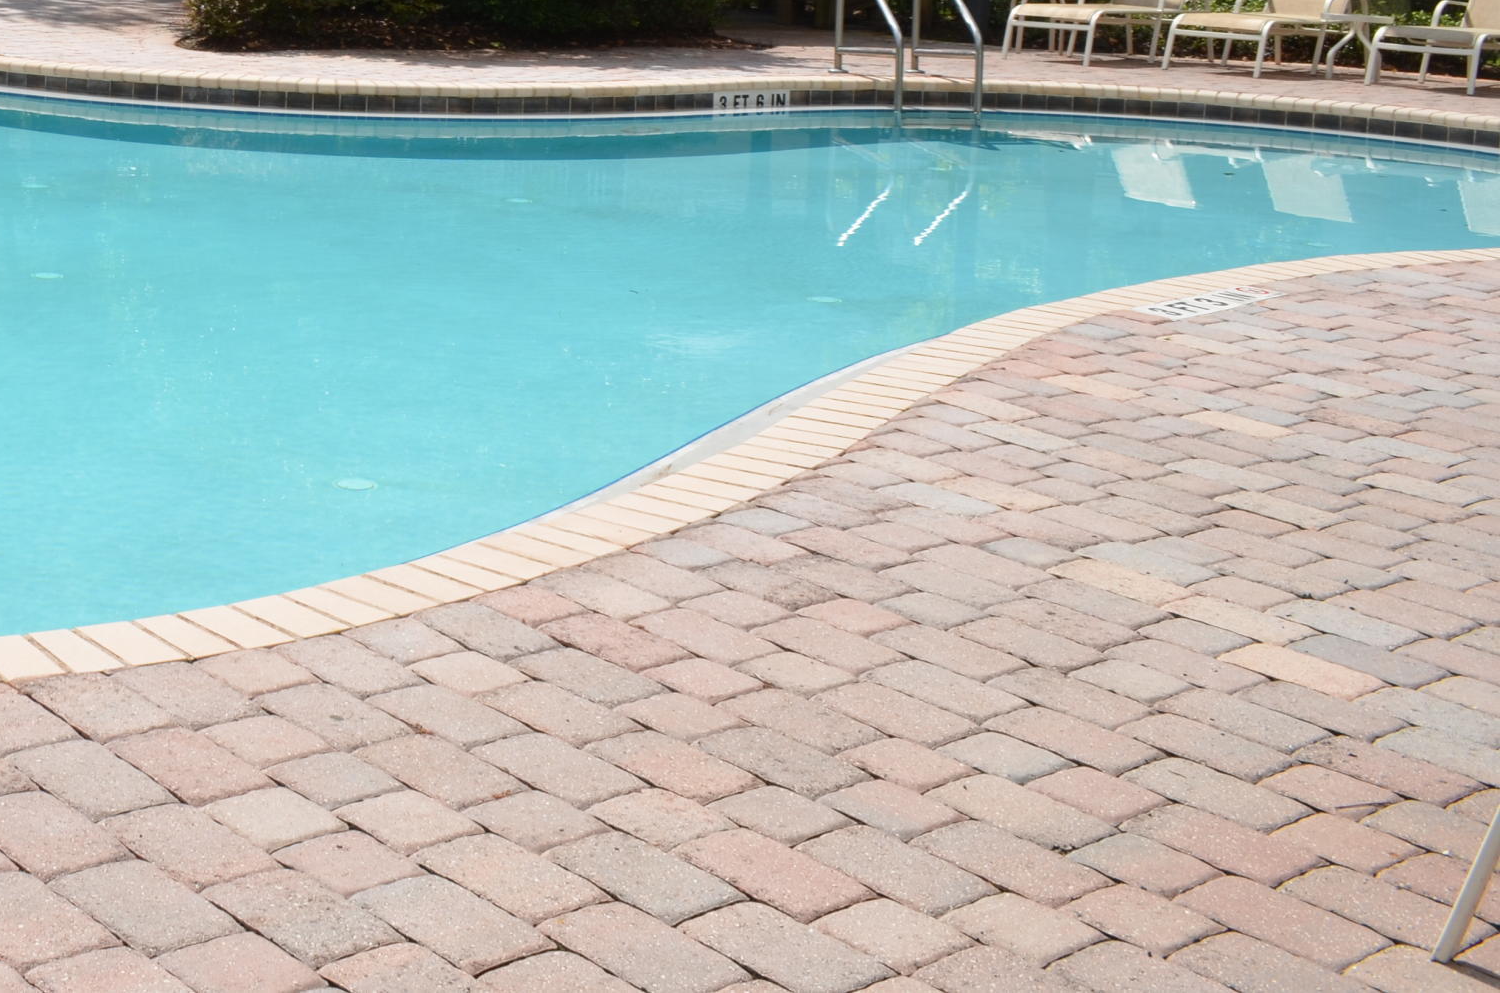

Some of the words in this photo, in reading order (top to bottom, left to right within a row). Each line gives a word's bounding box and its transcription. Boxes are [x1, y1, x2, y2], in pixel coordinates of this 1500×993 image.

[719, 95, 727, 108] 3
[733, 94, 750, 108] FT
[771, 93, 786, 107] IN
[1164, 301, 1210, 313] FT
